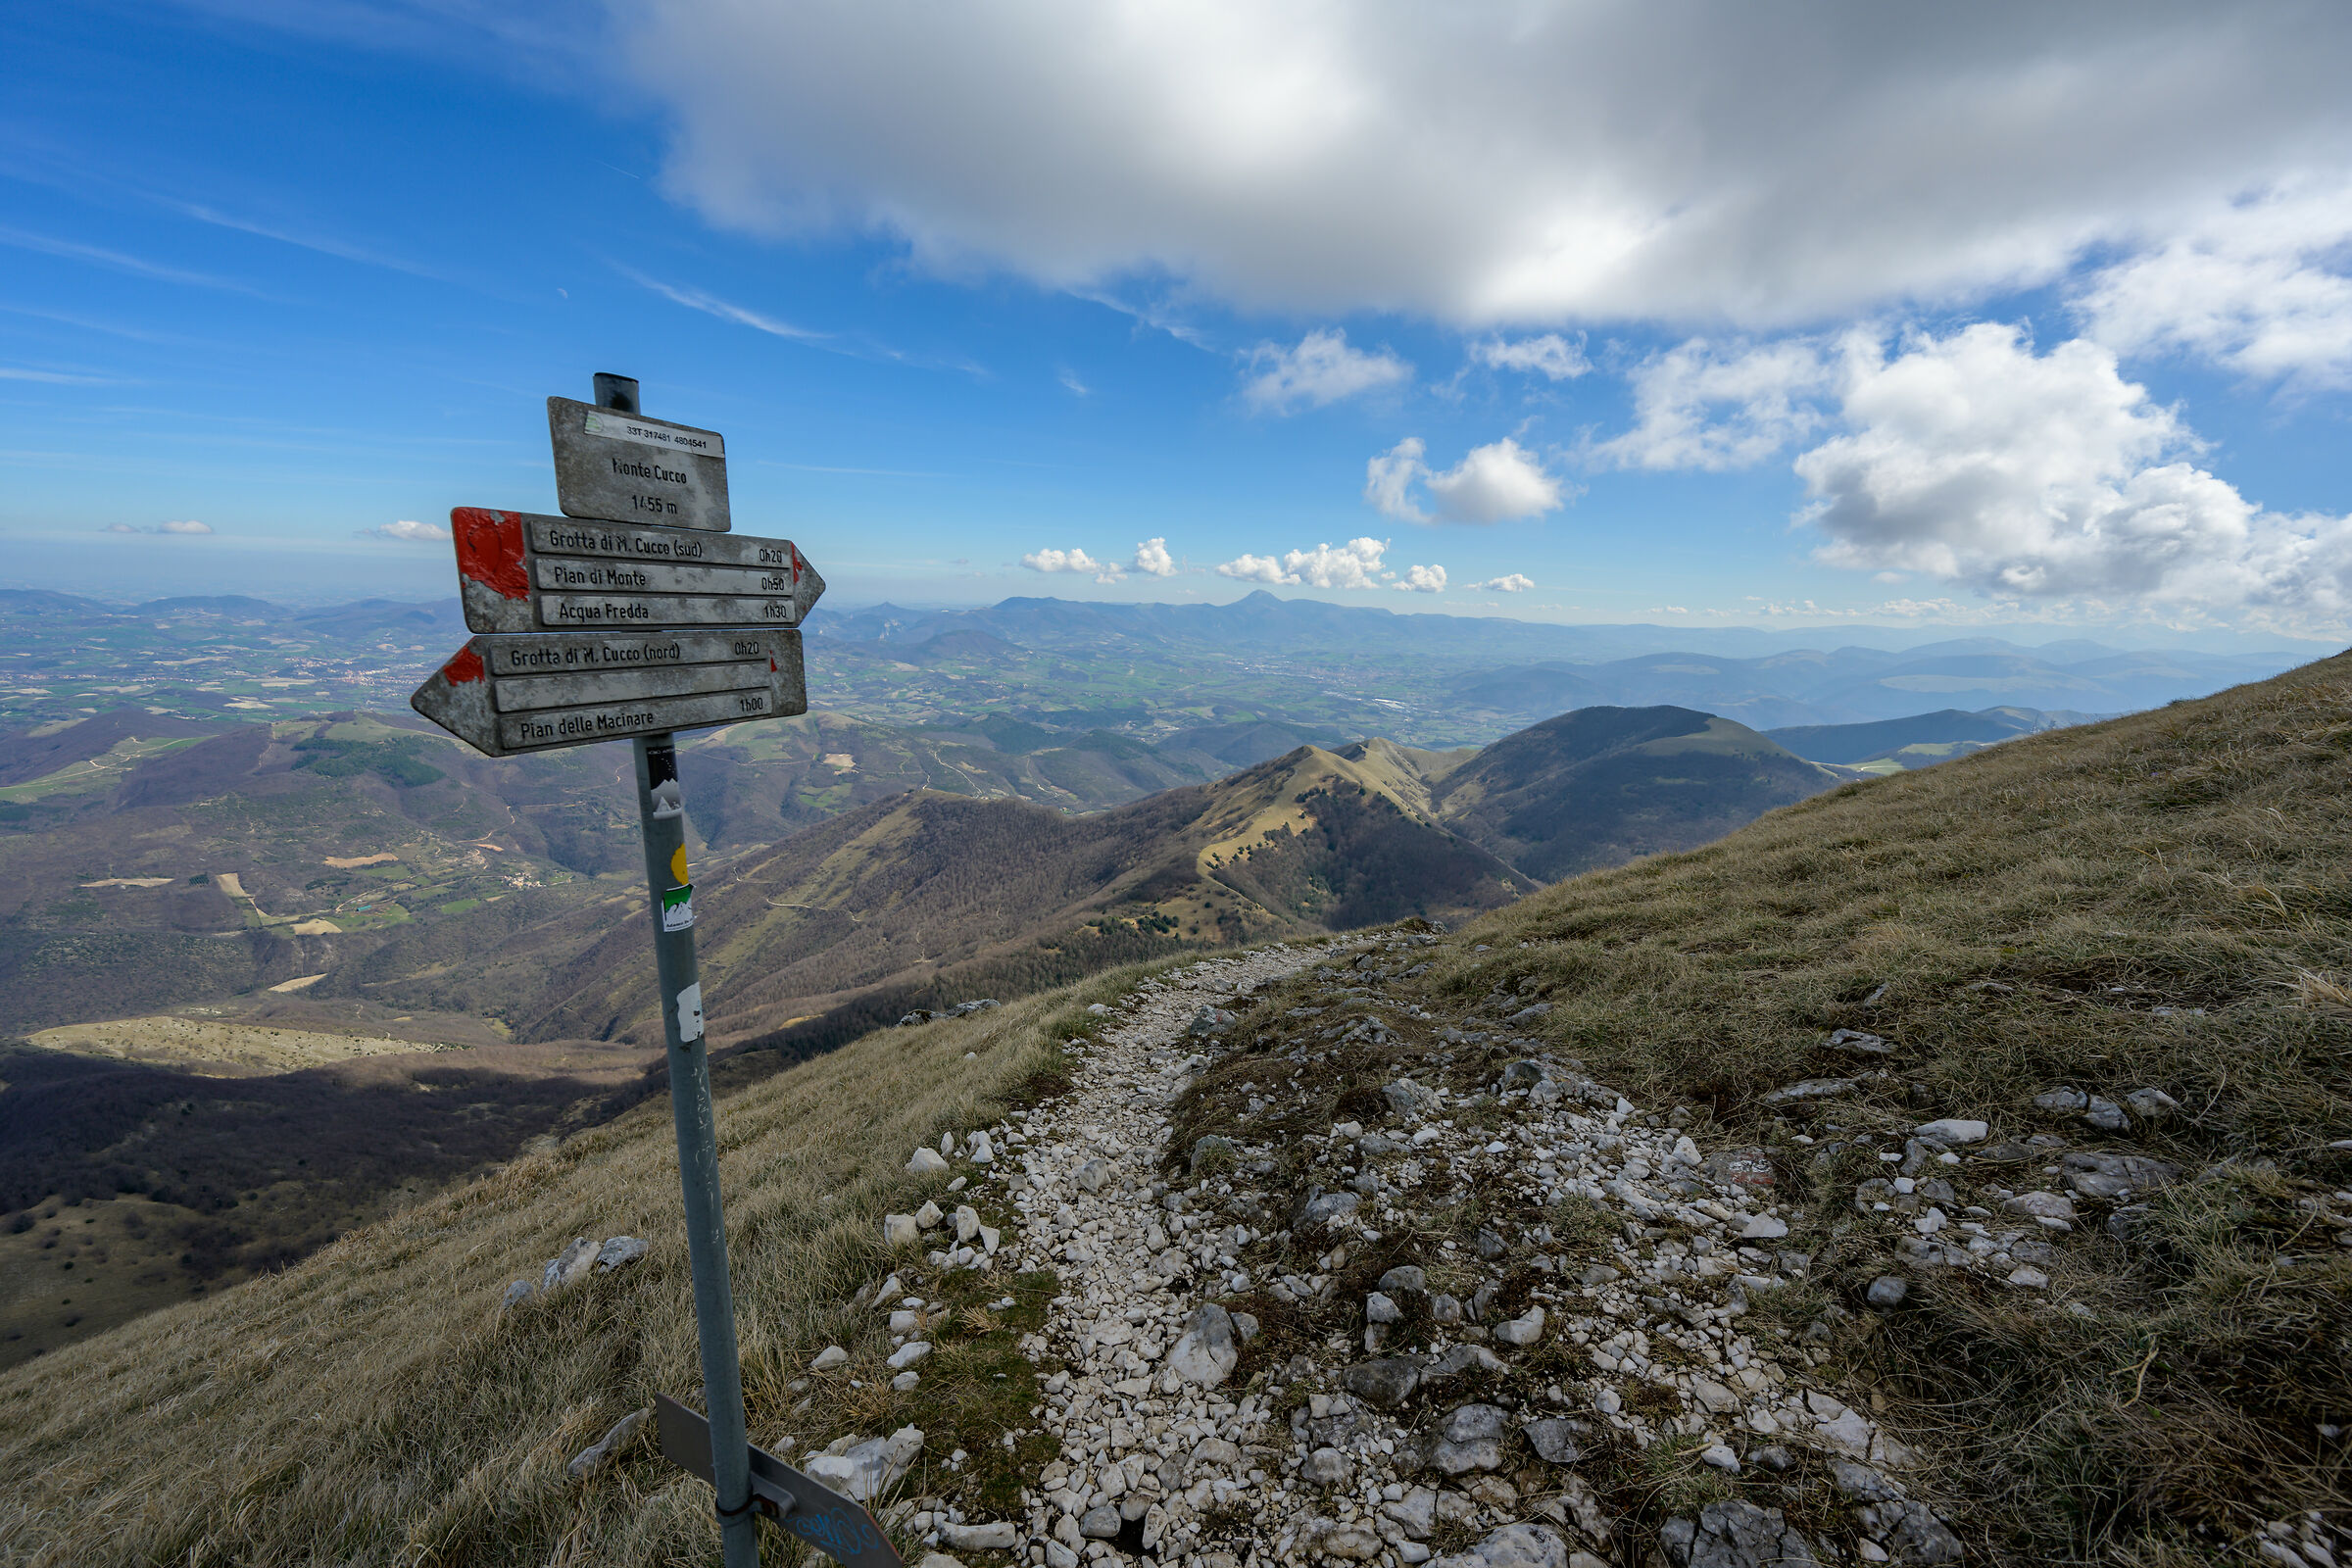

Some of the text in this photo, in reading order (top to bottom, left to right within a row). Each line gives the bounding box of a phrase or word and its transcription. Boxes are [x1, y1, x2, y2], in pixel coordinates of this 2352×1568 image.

[627, 425, 707, 449] 33T 317481 4804541
[655, 466, 687, 484] Cucco
[632, 495, 677, 514] 1455 m
[550, 530, 783, 564] Grotta di M. Cucco (sud) 0h20
[555, 566, 785, 592] Pian di Monte 0h50
[560, 603, 787, 622] Acqua Fredda 1h30
[512, 642, 760, 666] Grotta di M. Cucco (nord) 0h20
[521, 697, 763, 739] Pian delle Macinare 1h00
